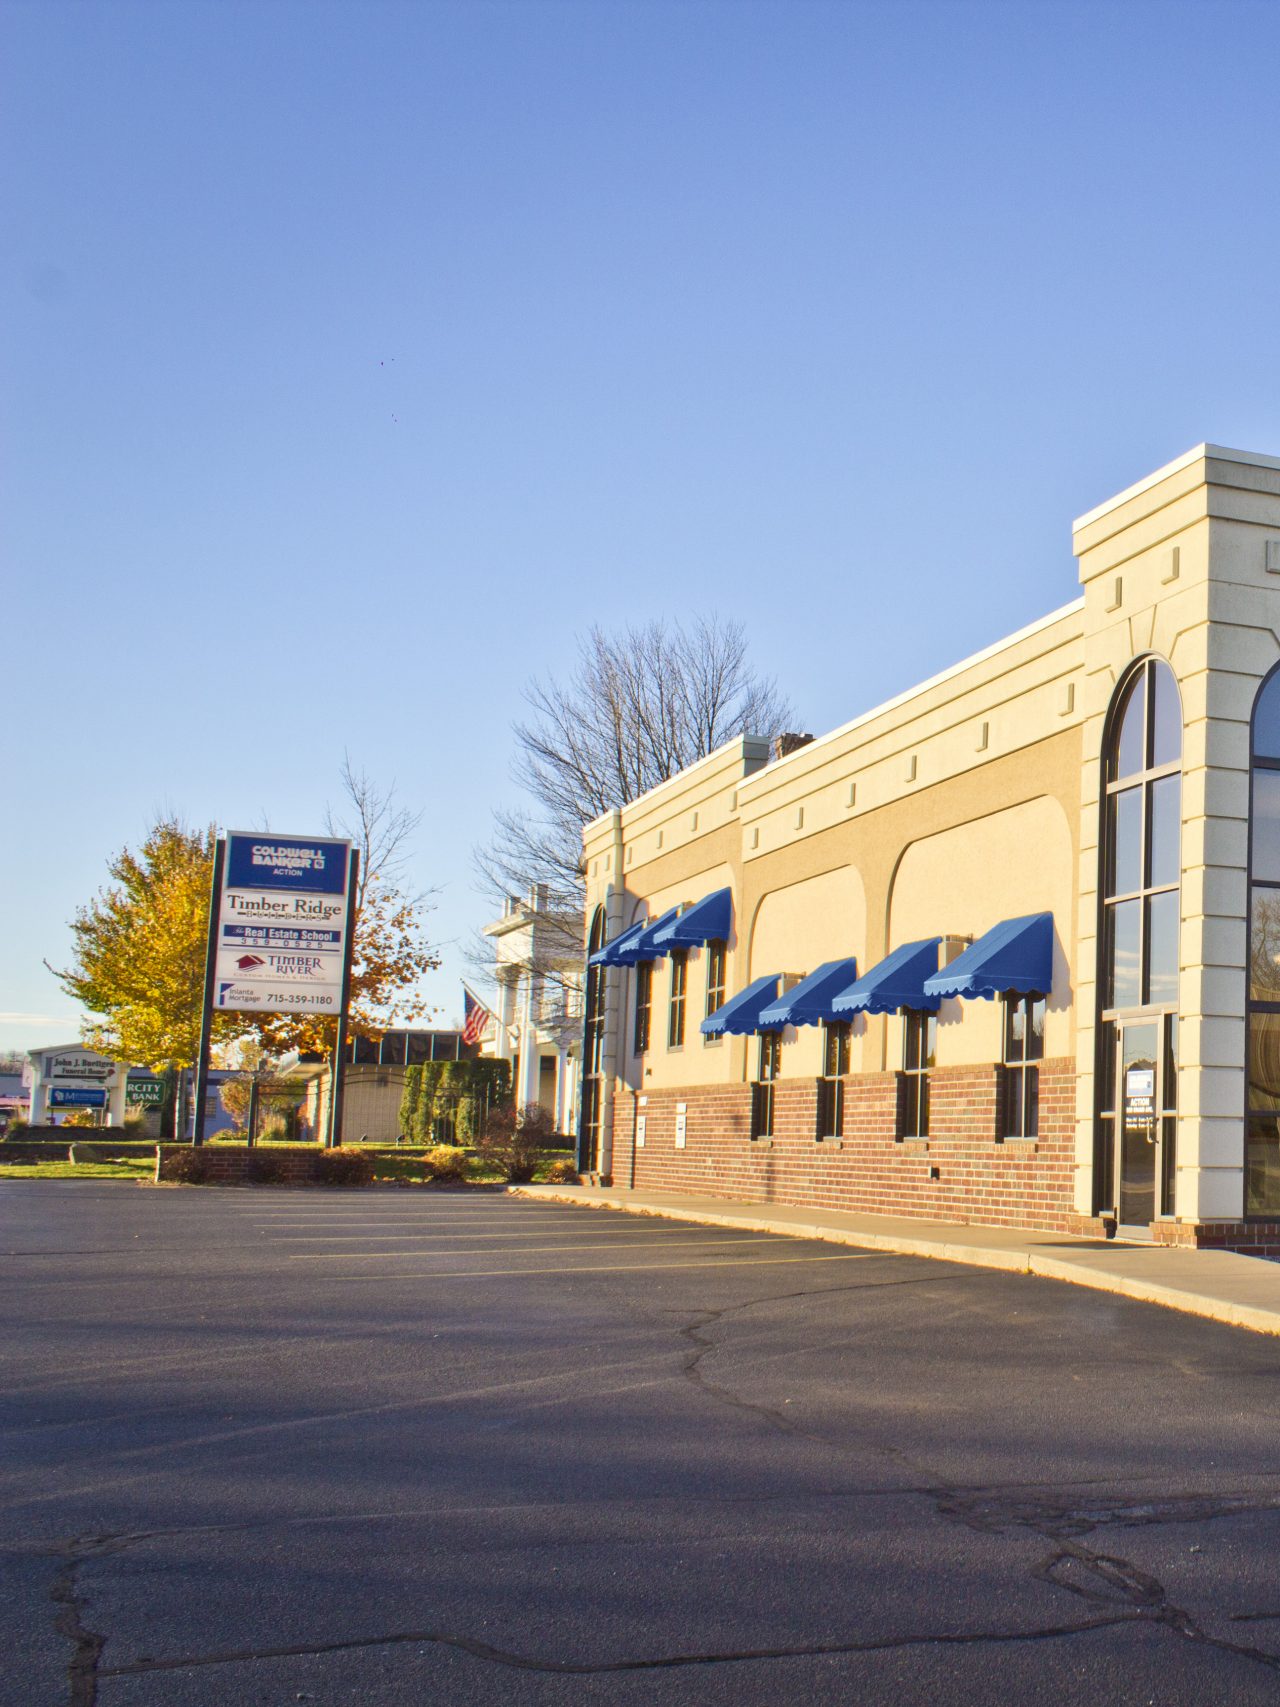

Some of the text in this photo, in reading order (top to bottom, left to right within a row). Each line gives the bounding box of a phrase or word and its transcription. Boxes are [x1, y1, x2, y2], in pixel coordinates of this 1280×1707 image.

[252, 855, 312, 868] BANKER
[273, 868, 302, 876] ACTION
[227, 895, 341, 918] Timber Ridge
[245, 927, 266, 937] Real
[269, 929, 299, 939] Estate
[301, 930, 333, 941] School
[268, 955, 326, 970] TIMBER
[276, 965, 316, 976] RIVER
[229, 994, 332, 1005] Mortgage 715-359-1180
[54, 1058, 72, 1067] John
[132, 1093, 160, 1101] BANK
